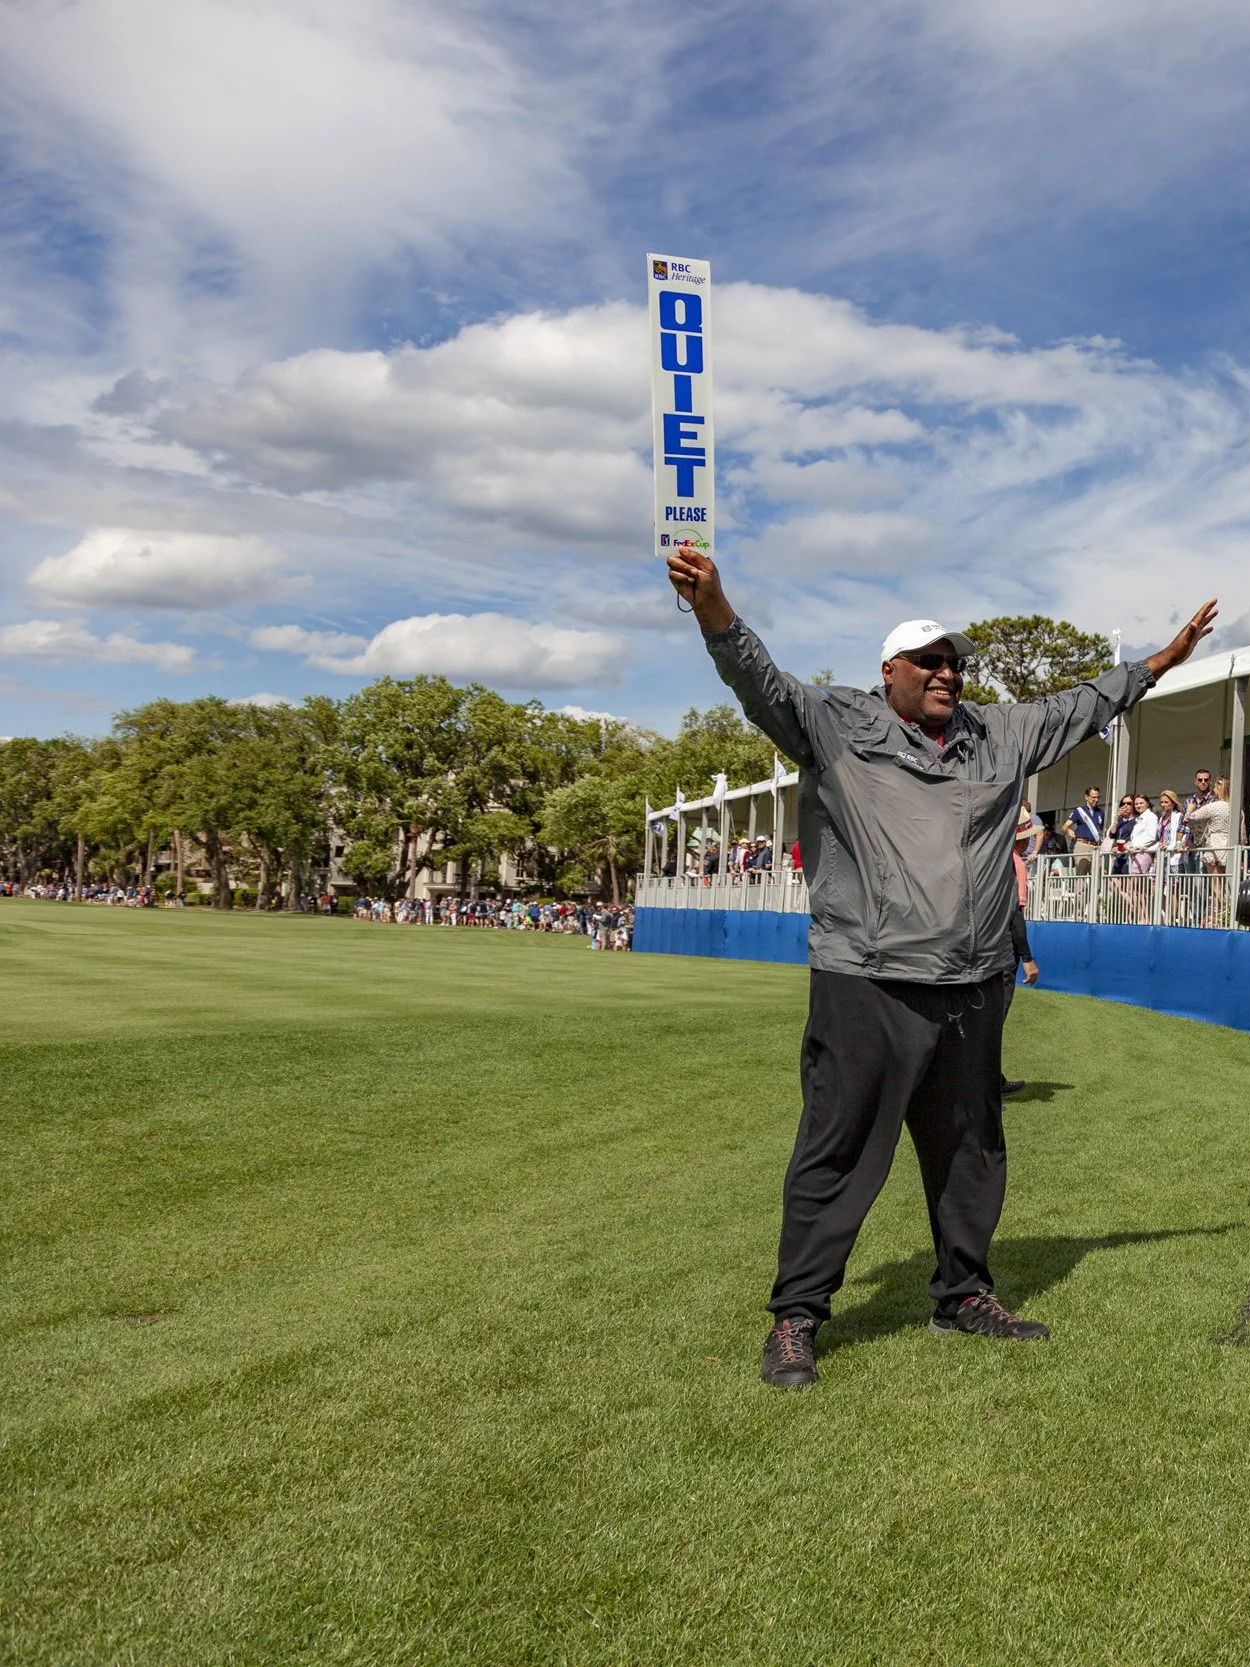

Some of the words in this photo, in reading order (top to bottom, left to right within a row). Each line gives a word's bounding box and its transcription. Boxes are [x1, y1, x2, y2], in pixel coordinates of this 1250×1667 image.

[671, 262, 691, 273] RBC
[671, 273, 705, 285] Heritage
[659, 291, 705, 498] QUIET
[666, 506, 706, 522] PLEASE
